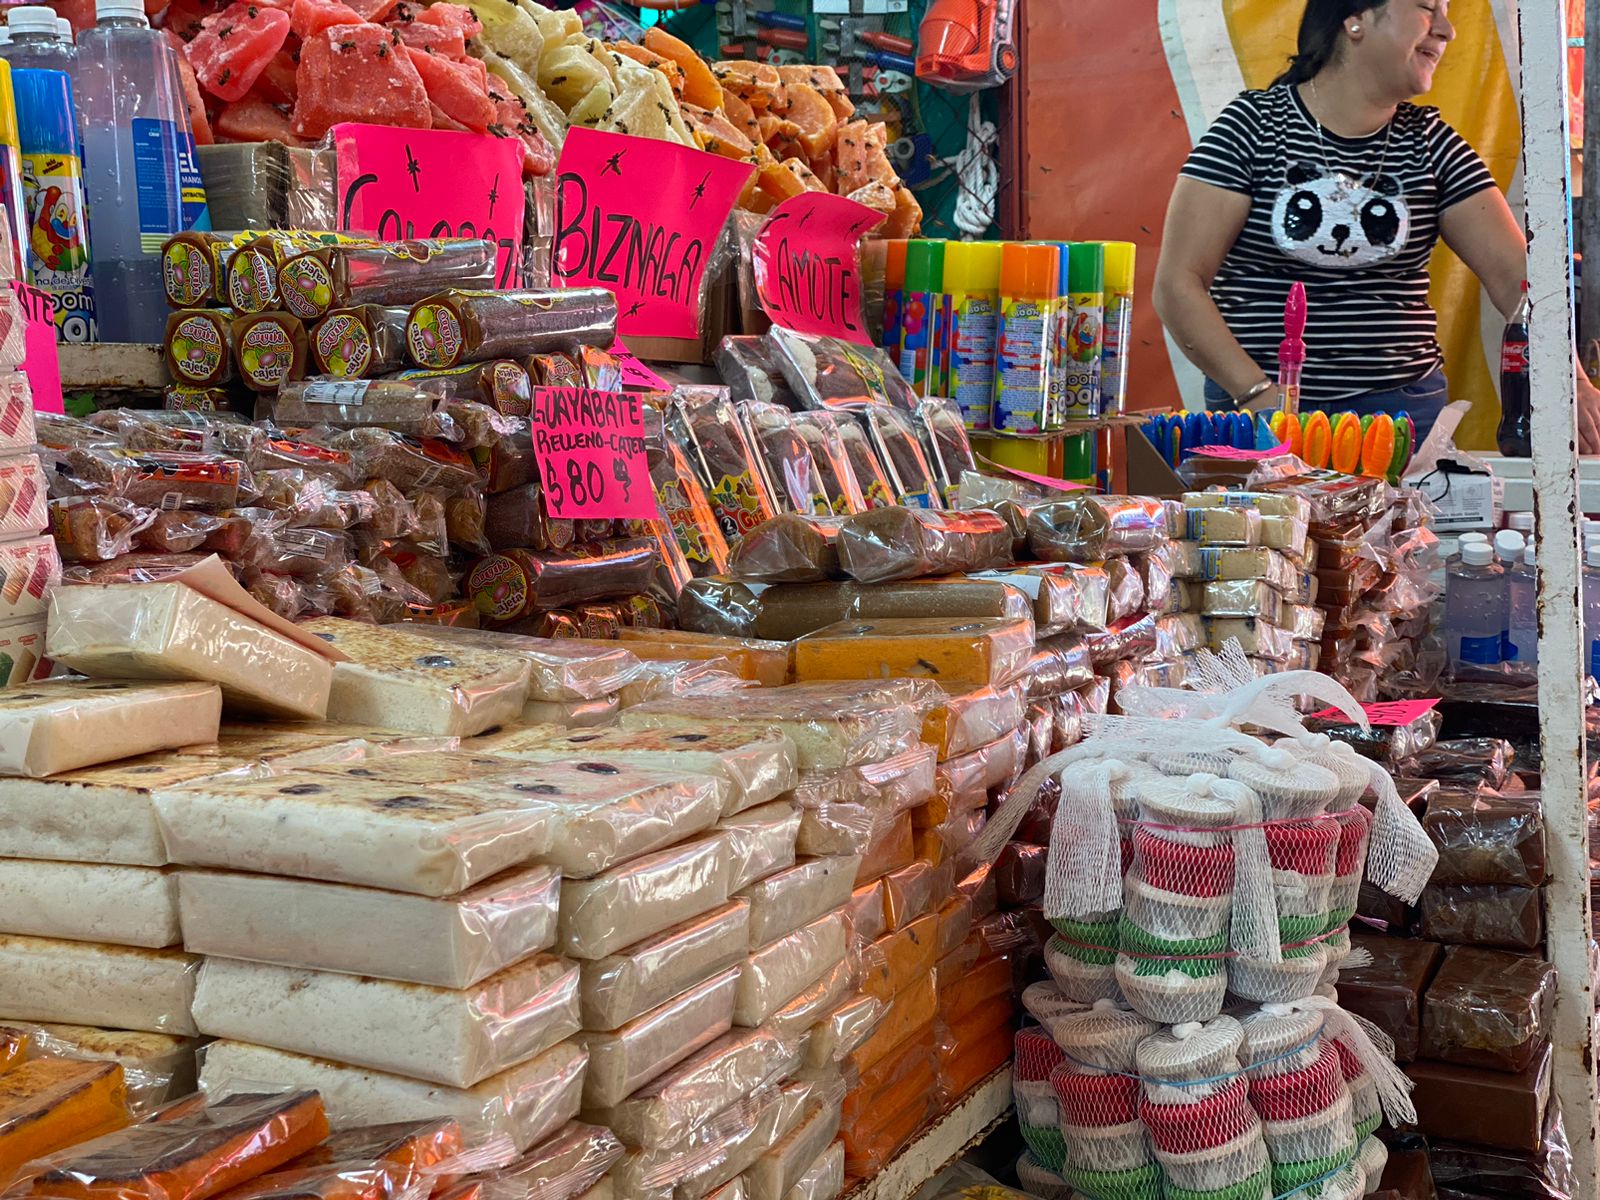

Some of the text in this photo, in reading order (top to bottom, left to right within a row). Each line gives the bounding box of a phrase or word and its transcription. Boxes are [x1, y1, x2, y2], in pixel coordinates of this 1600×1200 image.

[553, 173, 702, 305] BIZNAGA
[756, 213, 858, 331] CAMOTE
[15, 282, 54, 327] ATE
[344, 342, 370, 376] cajeta
[411, 322, 427, 361] cajeta
[179, 358, 210, 375] cajeta
[739, 508, 767, 528] Gua
[494, 592, 525, 615] ajeta
